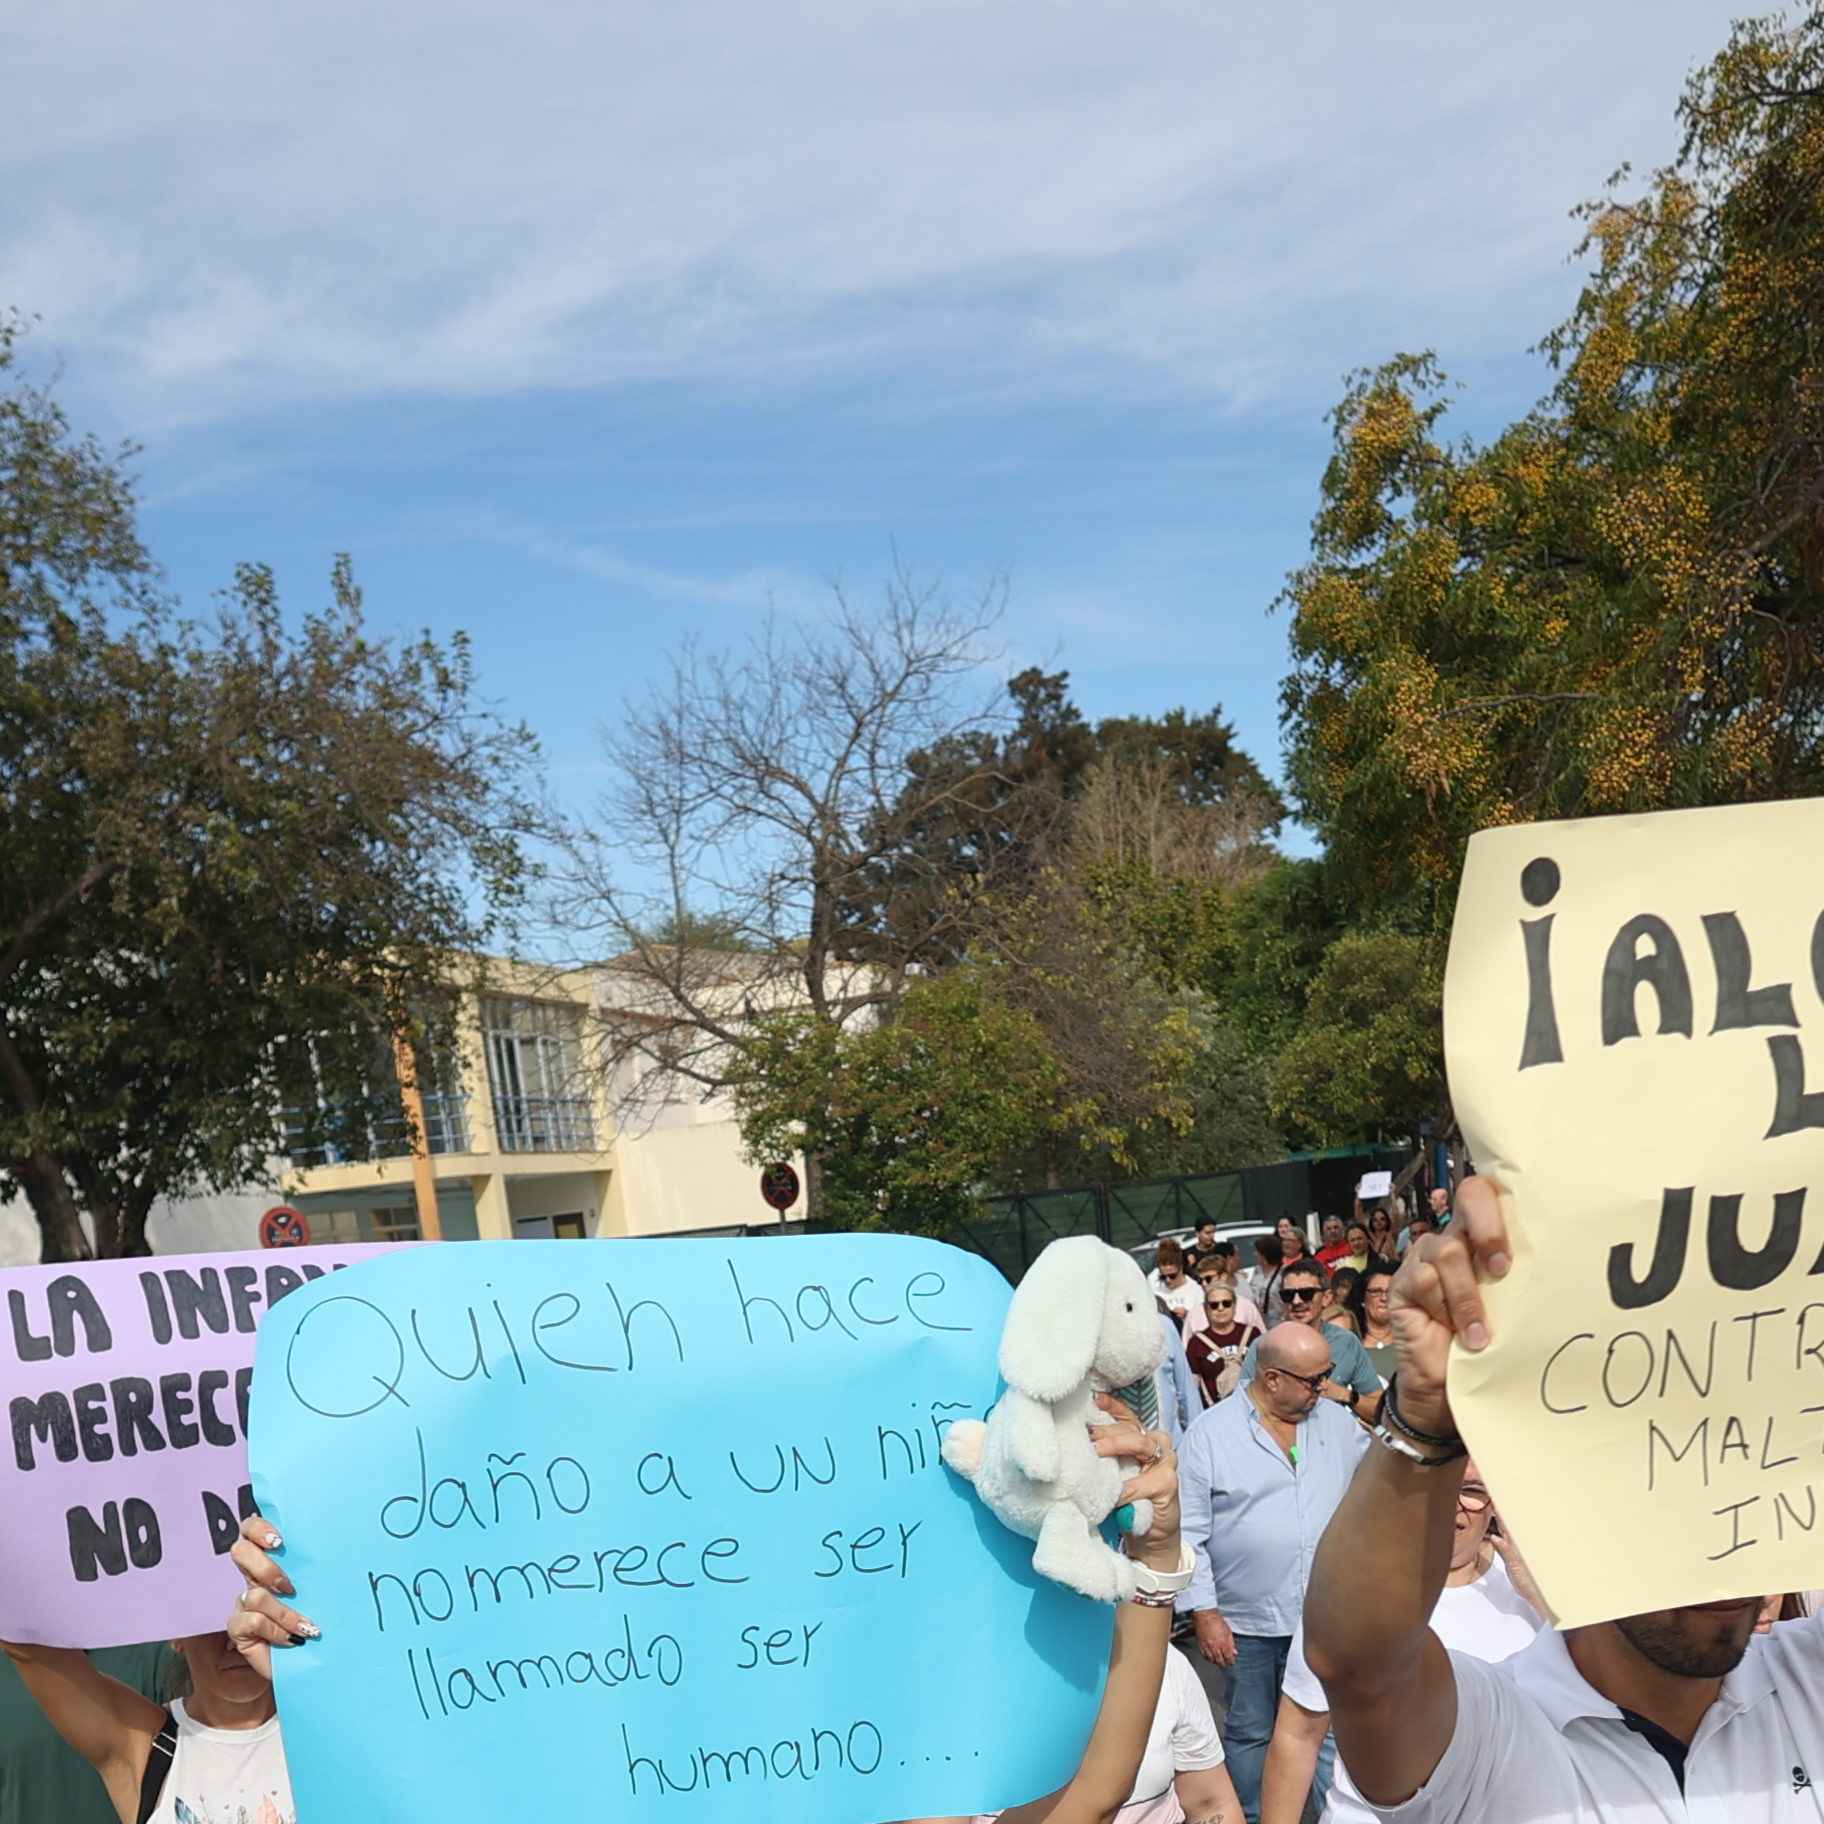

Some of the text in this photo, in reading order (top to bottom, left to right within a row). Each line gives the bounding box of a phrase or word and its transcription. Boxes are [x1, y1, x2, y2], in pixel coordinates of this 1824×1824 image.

[139, 1263, 349, 1345] INFA
[287, 1258, 974, 1418] Quien hace
[380, 1425, 591, 1540] daño
[637, 1452, 693, 1501] a
[877, 1401, 996, 1481] niñ
[65, 1497, 163, 1582] NO
[814, 1519, 924, 1579] ser
[408, 1614, 824, 1721] llamado ser
